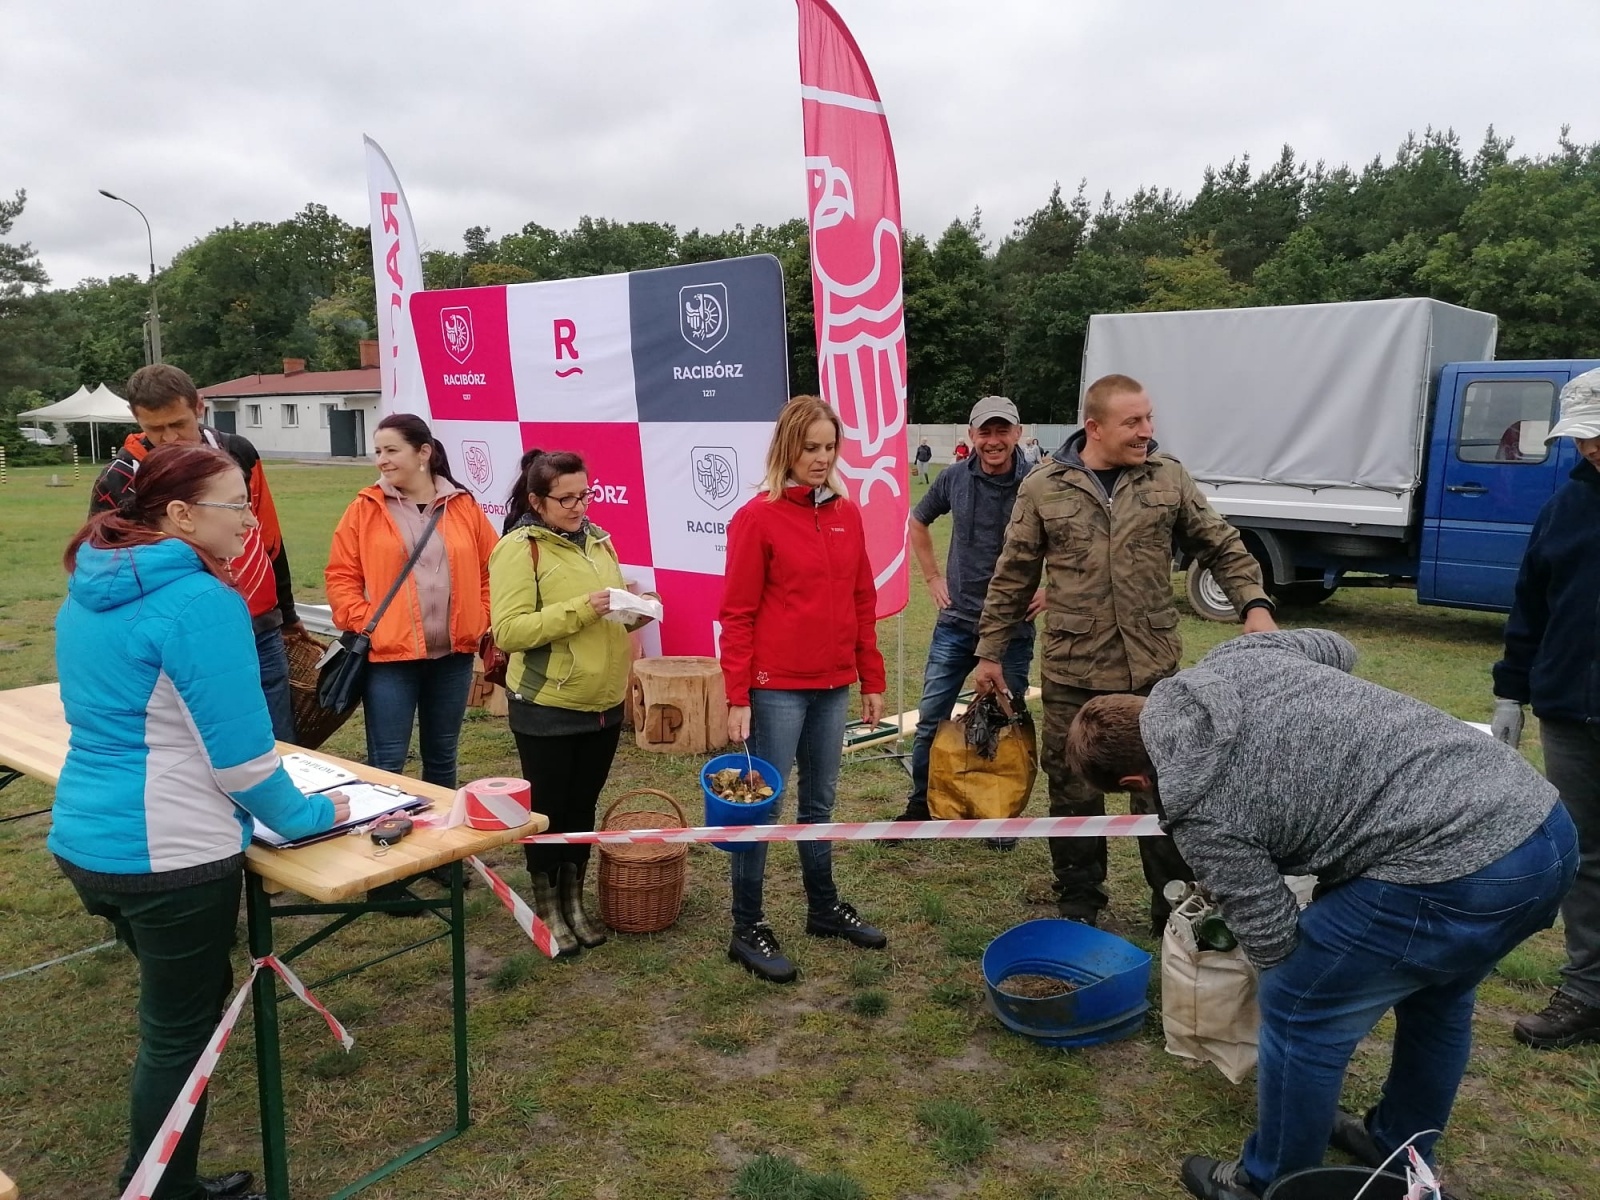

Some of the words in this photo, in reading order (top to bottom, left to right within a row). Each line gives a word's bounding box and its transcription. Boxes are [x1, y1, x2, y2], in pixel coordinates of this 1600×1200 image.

[553, 318, 579, 360] R
[443, 369, 487, 386] RACIBÓRZ
[672, 360, 744, 380] RACIBÓRZ
[702, 389, 716, 397] 1217
[686, 519, 730, 535] RACIB
